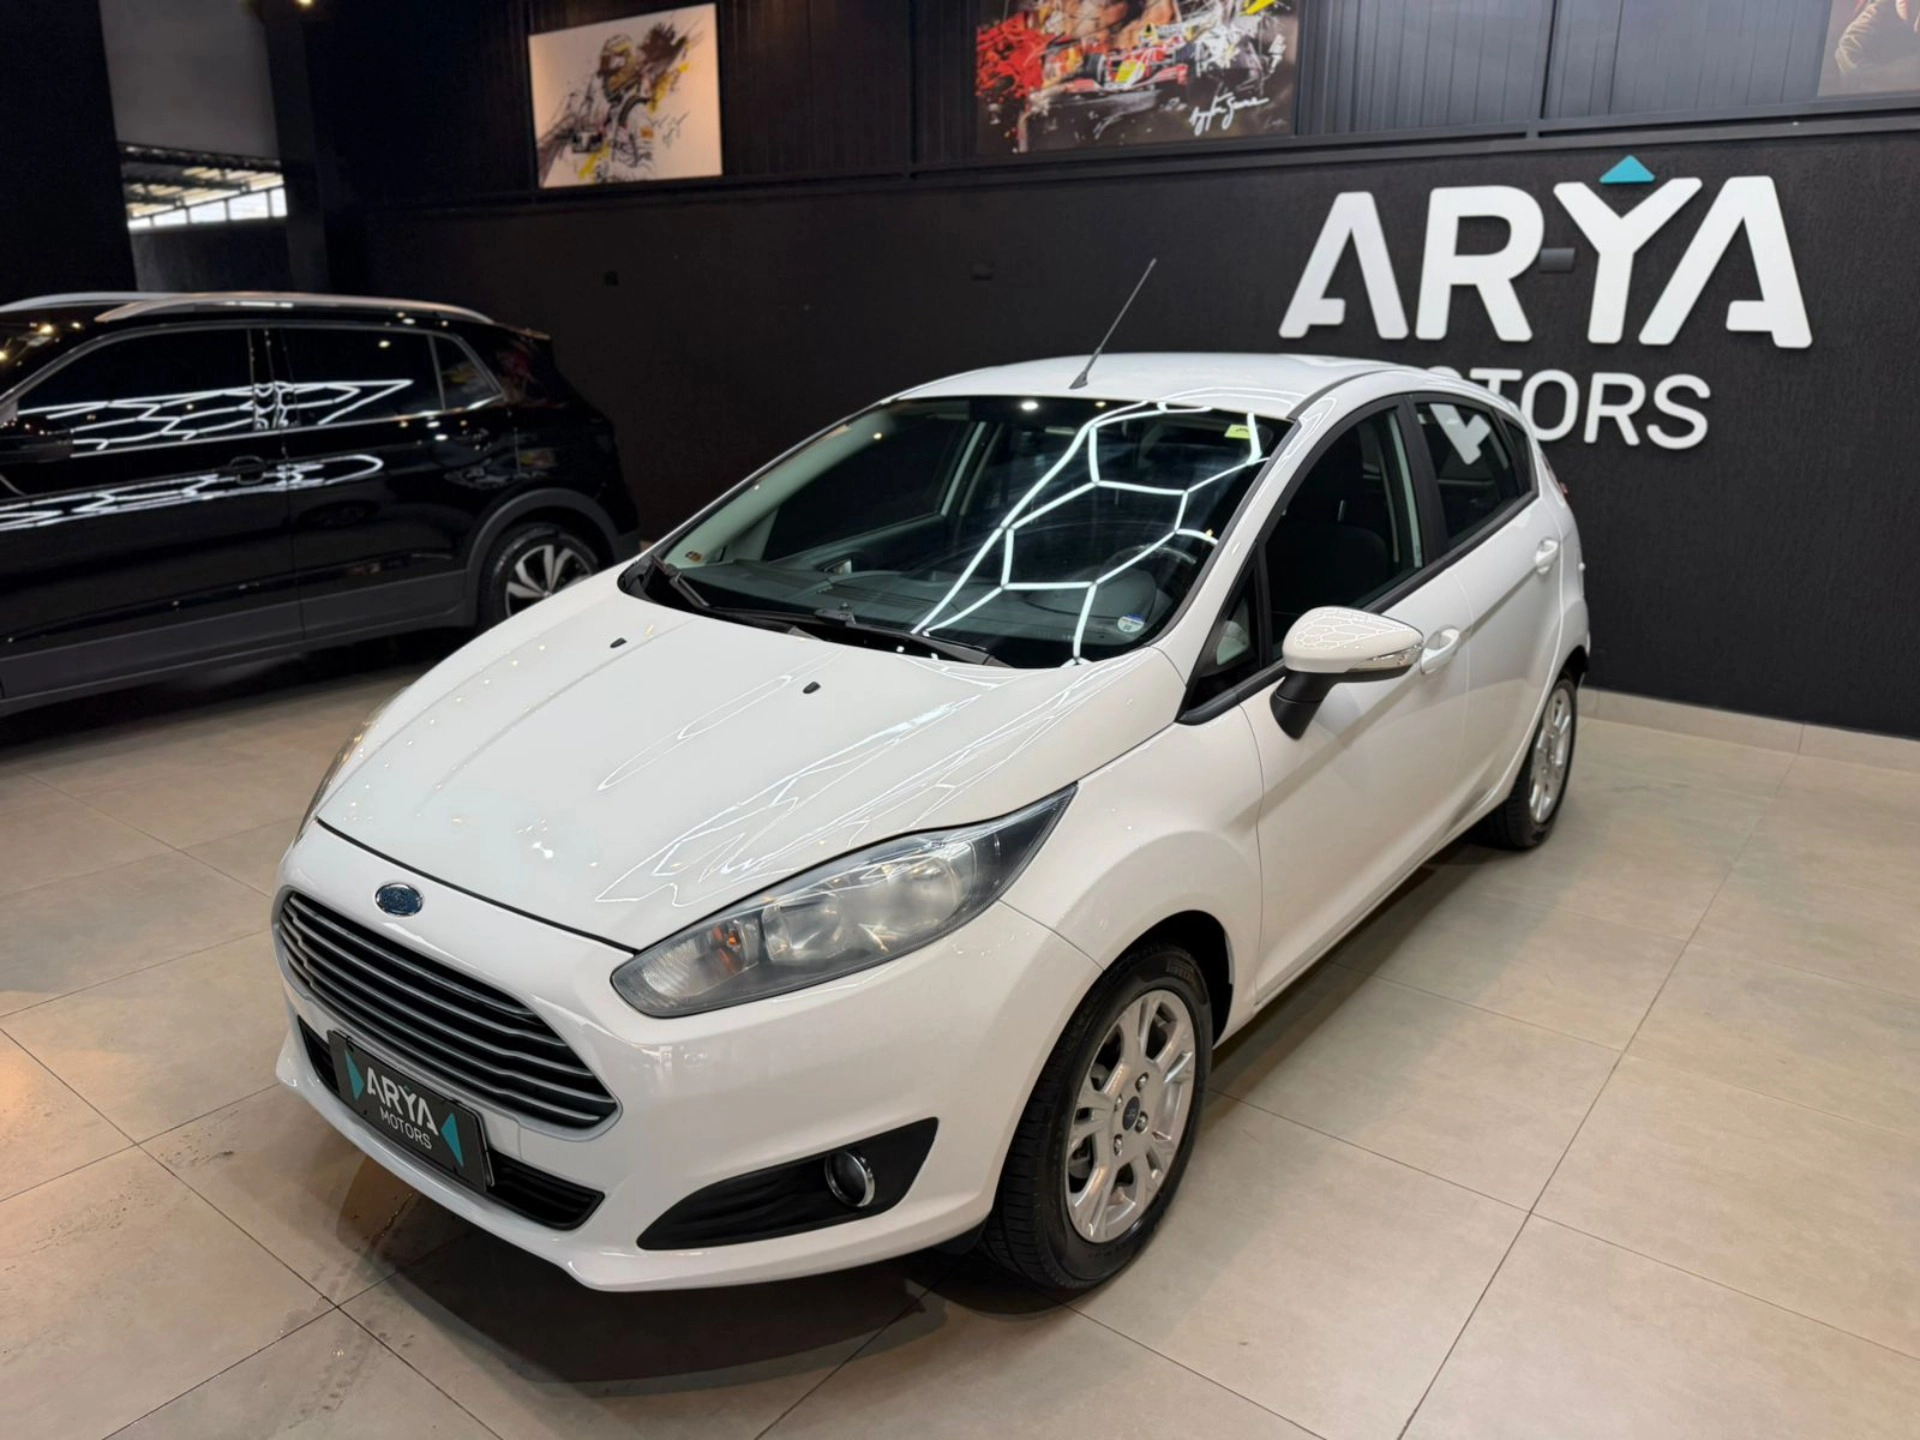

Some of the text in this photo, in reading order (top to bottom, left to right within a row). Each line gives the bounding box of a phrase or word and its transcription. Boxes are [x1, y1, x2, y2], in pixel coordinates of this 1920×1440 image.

[1279, 175, 1812, 348] ARYA
[1427, 366, 1711, 449] TORS
[366, 1066, 439, 1136] ARYA
[380, 1104, 432, 1150] MOTORS
